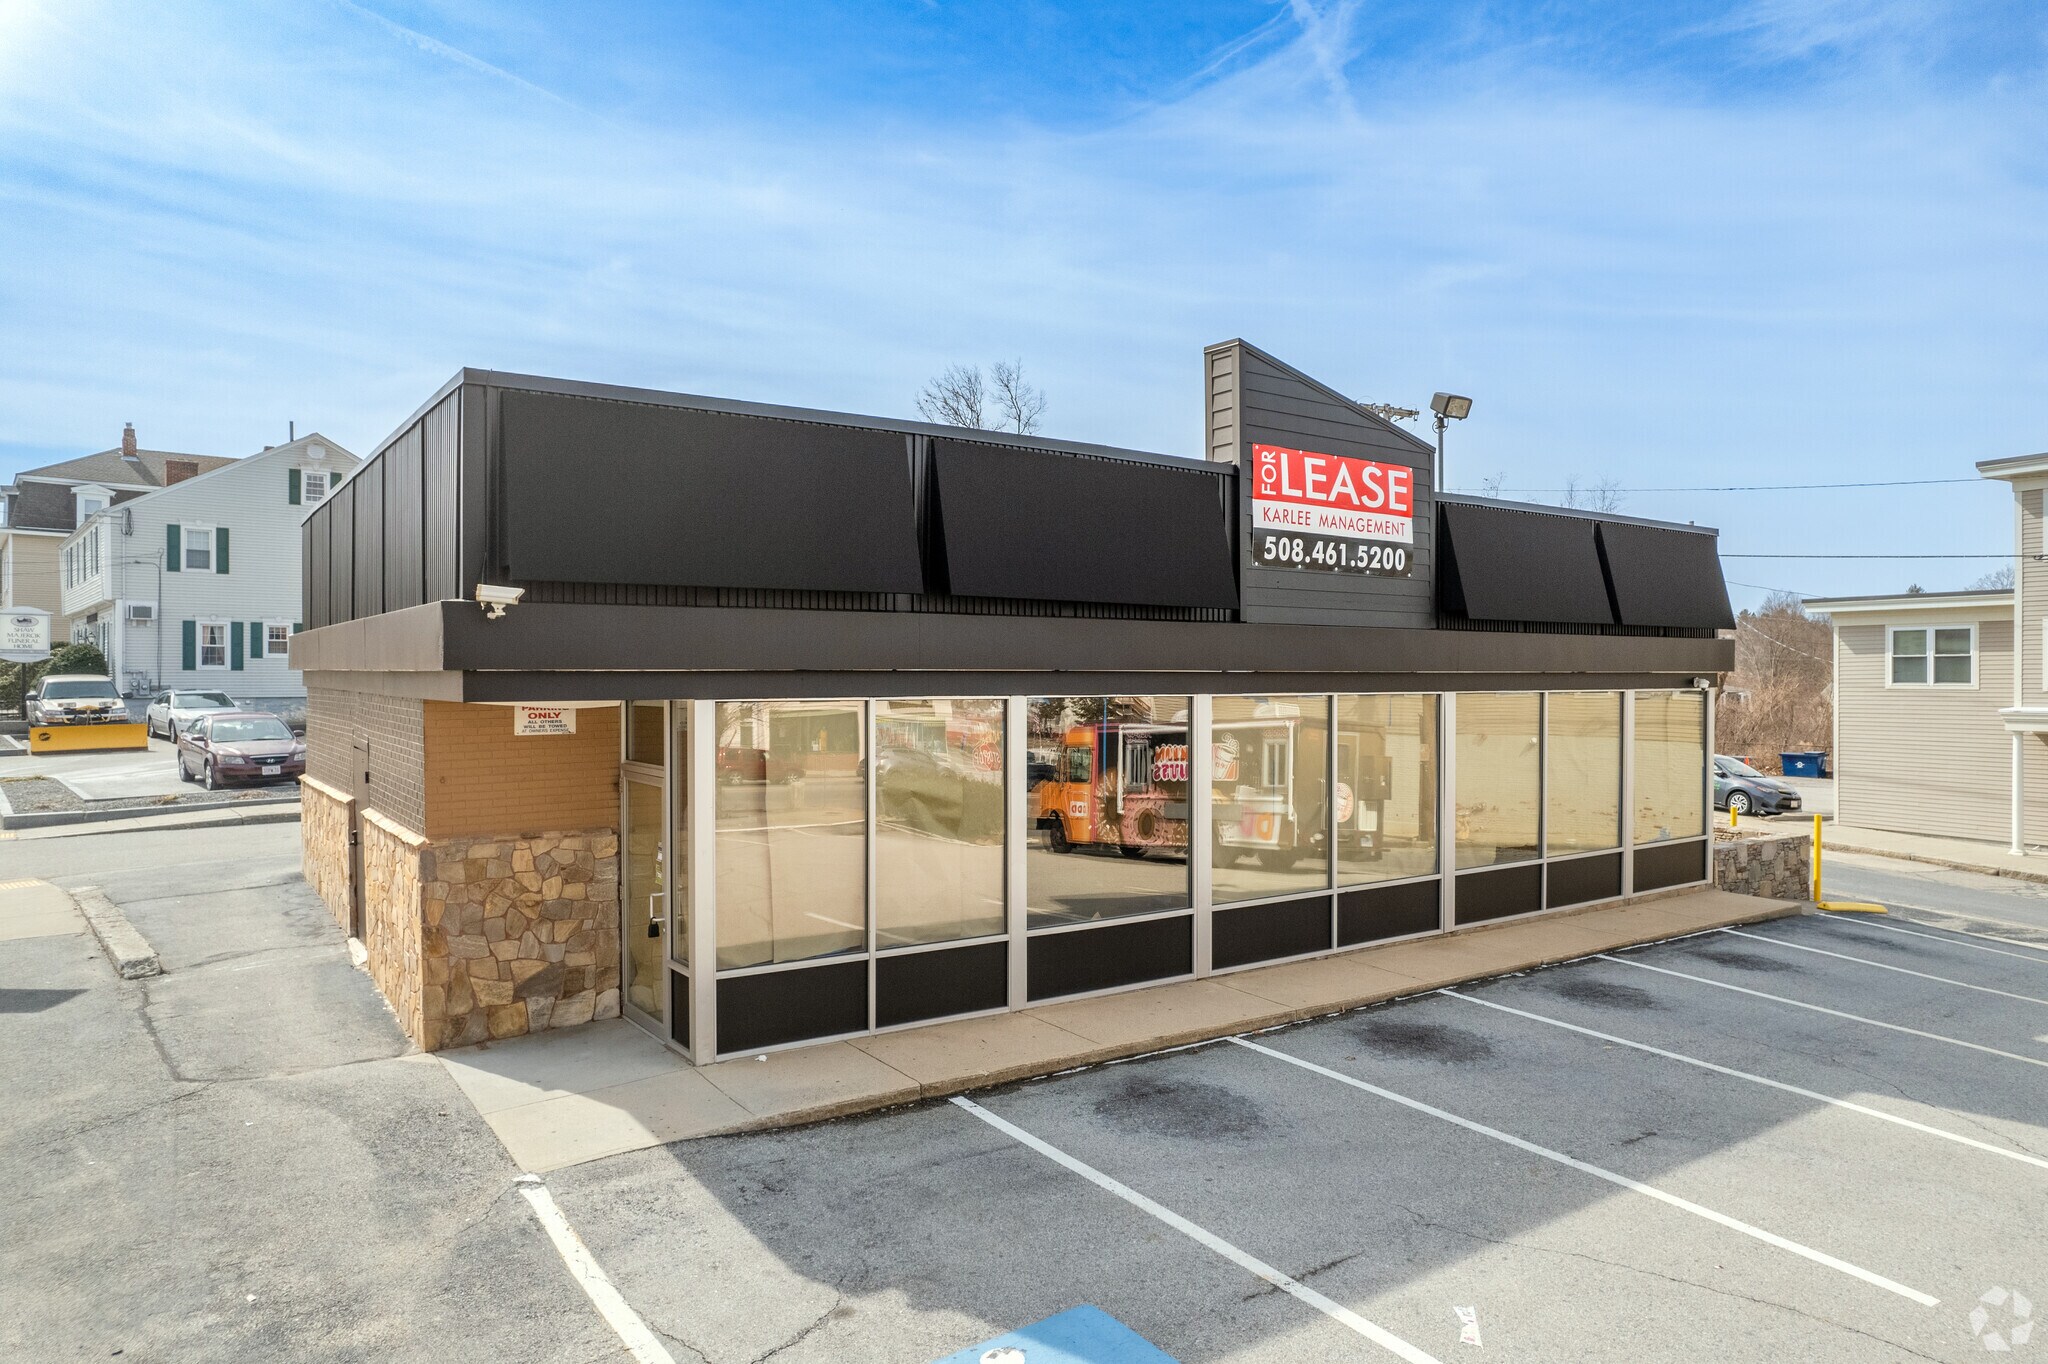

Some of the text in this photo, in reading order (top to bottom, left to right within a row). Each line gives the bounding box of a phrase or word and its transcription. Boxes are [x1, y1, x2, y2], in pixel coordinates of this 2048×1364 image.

[1261, 451, 1277, 495] FOR
[1280, 453, 1408, 512] LEASE
[1263, 506, 1406, 537] KARLEE MANAGEMENT
[1263, 536, 1406, 571] 508.461.5200
